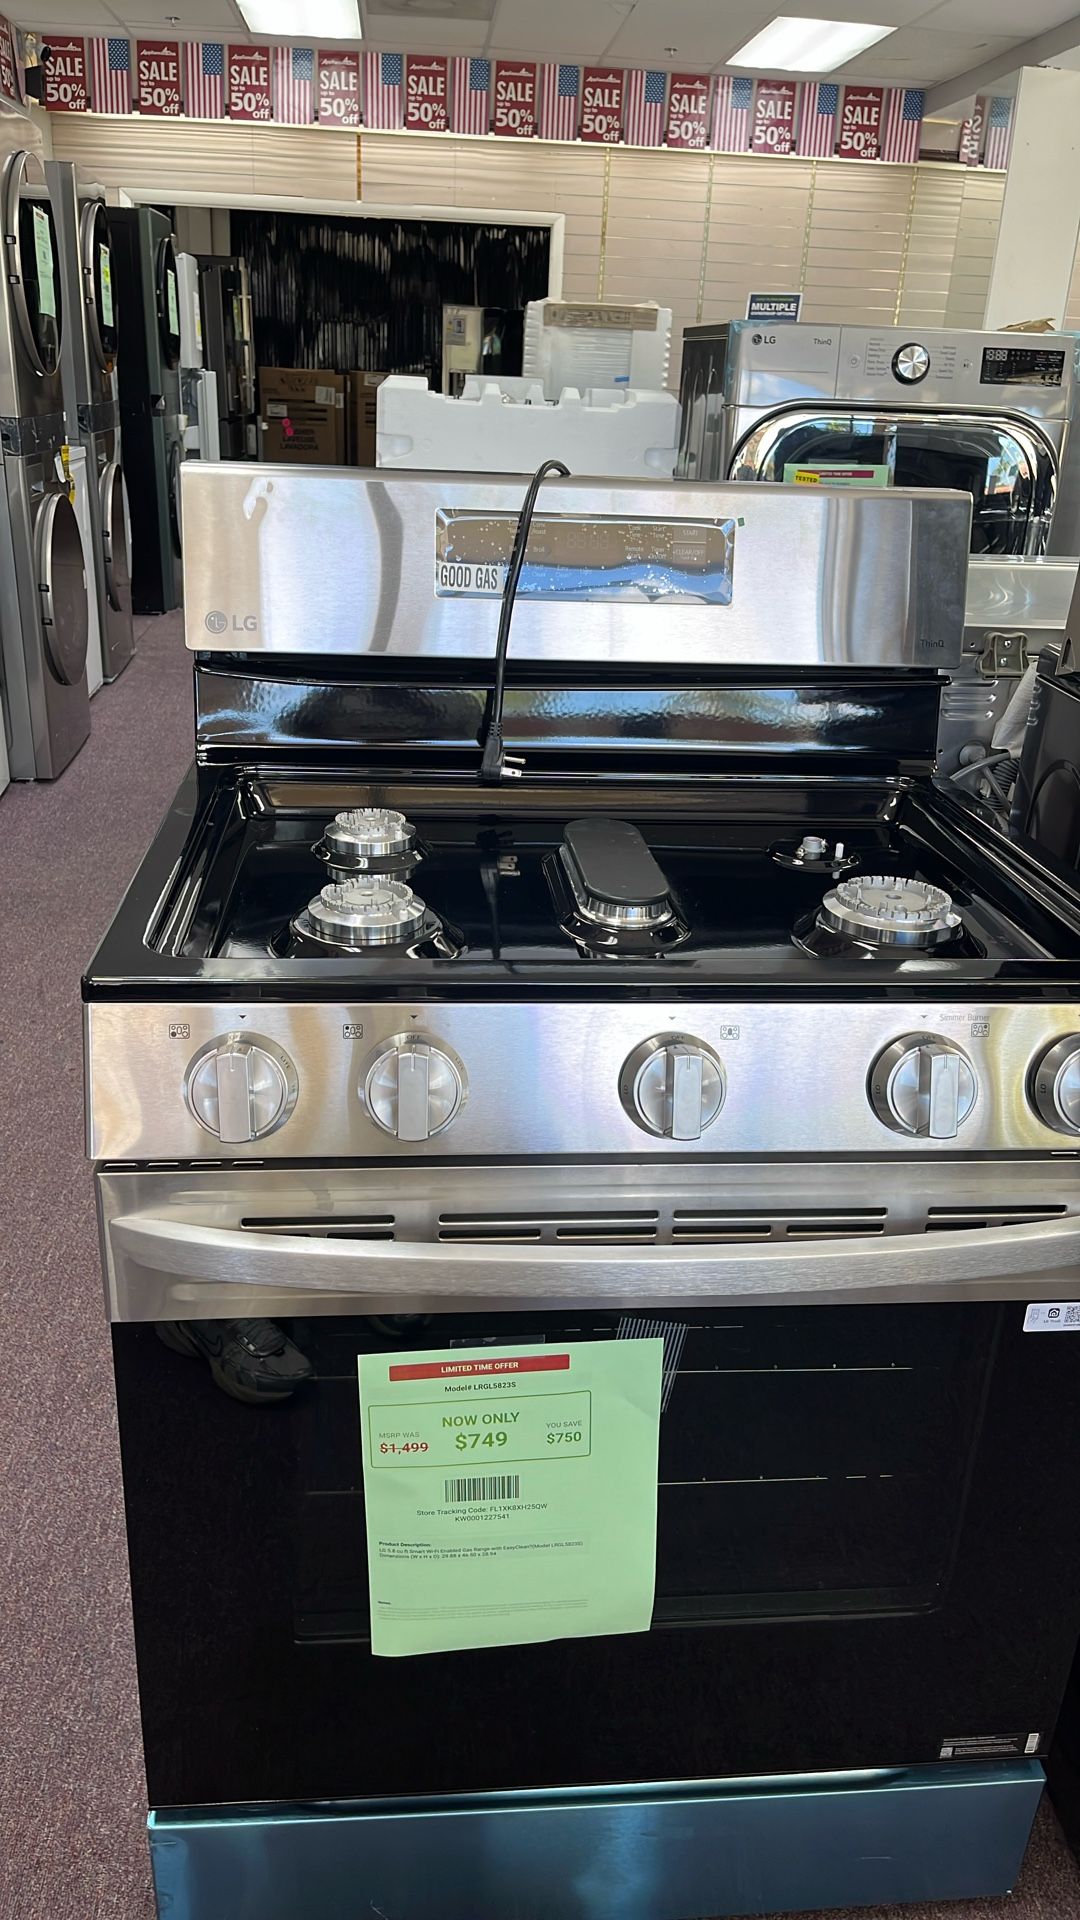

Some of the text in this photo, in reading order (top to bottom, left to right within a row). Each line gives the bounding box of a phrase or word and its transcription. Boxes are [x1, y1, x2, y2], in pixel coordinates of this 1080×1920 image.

[46, 56, 83, 76] SALE
[140, 60, 177, 81] SALE
[230, 65, 268, 86] SALE
[320, 70, 357, 91] SALE
[46, 84, 86, 102] 50%
[408, 75, 445, 96] SALE
[497, 81, 533, 102] SALE
[68, 98, 86, 110] off
[140, 87, 179, 106] 50%
[231, 92, 269, 112] 50%
[584, 87, 620, 108] SALE
[670, 93, 706, 114] SALE
[162, 104, 179, 114] off
[252, 108, 269, 119] off
[320, 97, 358, 117] 50%
[408, 103, 445, 122] 50%
[756, 99, 792, 120] SALE
[843, 105, 879, 126] SALE
[342, 114, 358, 124] off
[429, 119, 445, 129] off
[496, 108, 533, 128] 50%
[582, 115, 619, 134] 50%
[516, 125, 533, 135] off
[603, 131, 619, 141] off
[669, 120, 705, 140] 50%
[754, 126, 791, 145] 50%
[688, 137, 705, 147] off
[774, 142, 790, 152] off
[841, 132, 878, 149] 50%
[860, 147, 876, 158] off
[751, 303, 797, 311] MULTIPLE
[763, 336, 776, 344] LG
[795, 475, 818, 483] TESTED
[440, 564, 498, 590] GOOD GAS
[232, 614, 258, 632] LG
[920, 640, 944, 648] ThinQ
[940, 1014, 990, 1022] Simmer Burner
[441, 1365, 472, 1374] LIMITED
[494, 1362, 519, 1370] OFFER
[474, 1381, 516, 1390] LRGL5823S
[442, 1412, 520, 1428] NOW ONLY
[455, 1431, 508, 1452] $749
[546, 1432, 582, 1444] $750
[380, 1442, 429, 1454] $1,499
[437, 1508, 466, 1516] Tracking
[468, 1506, 487, 1514] Code:
